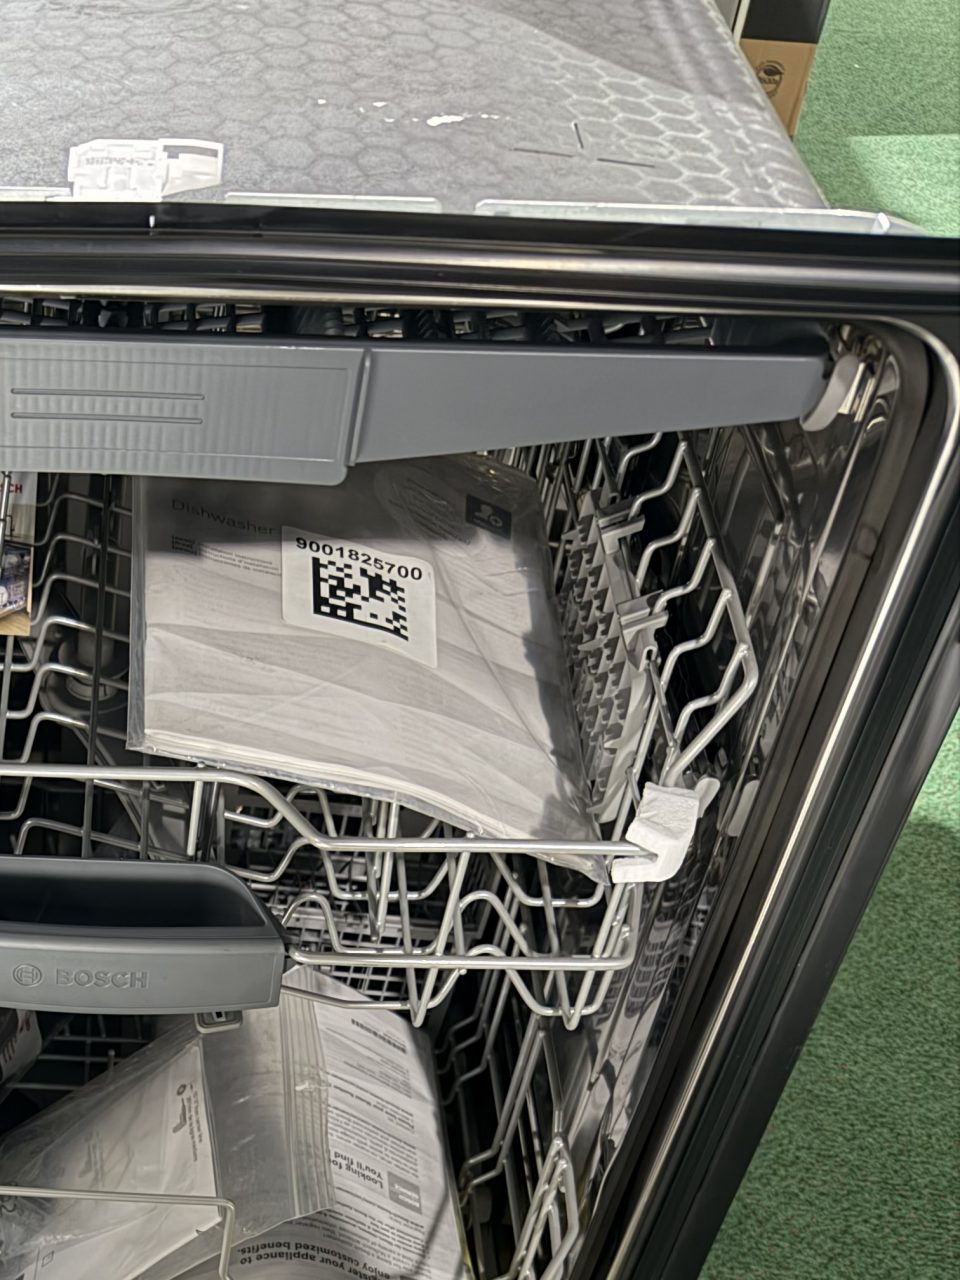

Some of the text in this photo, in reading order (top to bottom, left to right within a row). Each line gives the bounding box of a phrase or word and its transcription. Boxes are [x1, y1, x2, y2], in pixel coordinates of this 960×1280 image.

[171, 499, 274, 535] Dishwasher
[295, 536, 423, 580] 9001825700
[55, 967, 149, 989] BOSCH
[334, 1151, 383, 1180] You'll find
[345, 1163, 383, 1189] Looking
[237, 1241, 391, 1280] enjoy customized benefits.
[240, 1254, 252, 1265] to
[256, 1251, 317, 1262] appliance
[319, 1256, 346, 1271] your
